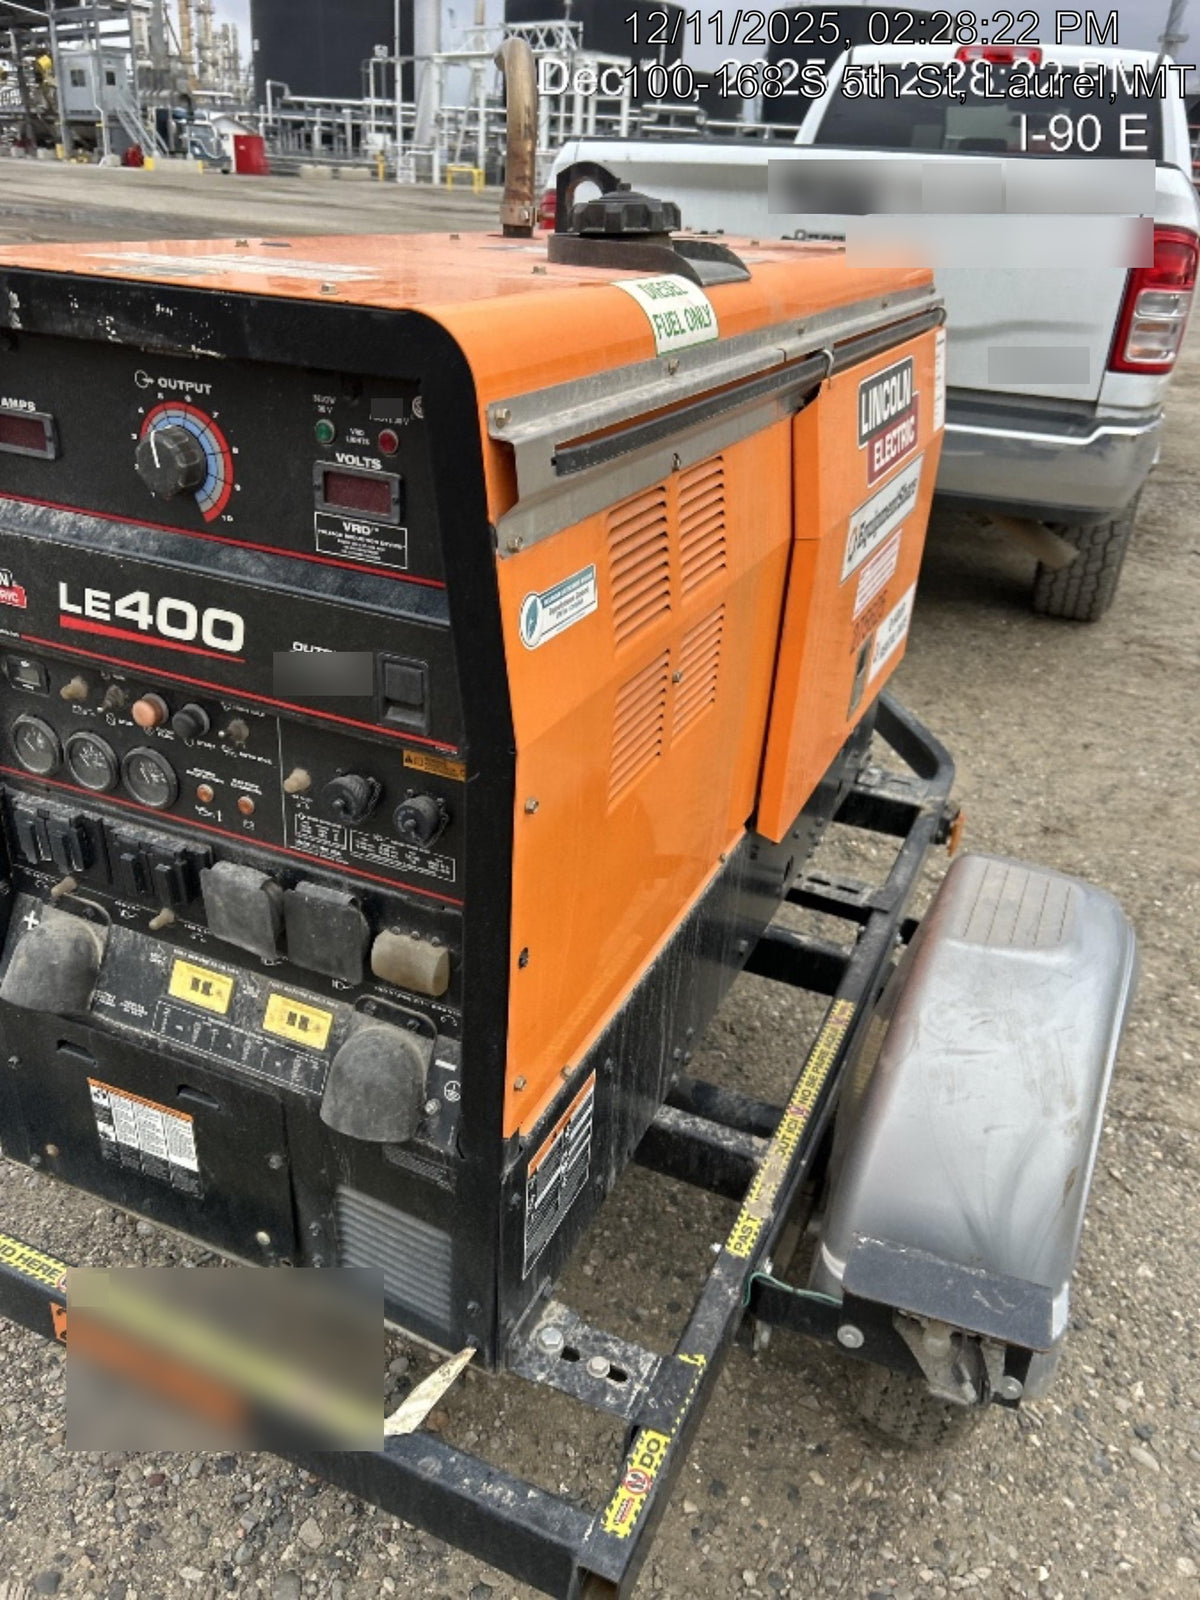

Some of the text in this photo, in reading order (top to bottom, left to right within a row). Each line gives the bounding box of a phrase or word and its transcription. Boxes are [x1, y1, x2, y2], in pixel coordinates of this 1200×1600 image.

[652, 304, 712, 339] FUEL ONLY
[157, 377, 212, 395] OUTPUT
[861, 366, 912, 436] LINCOLN
[873, 415, 915, 473] ELECTRIC
[335, 452, 383, 470] VOLTS
[58, 581, 245, 652] LE400
[16, 1252, 63, 1281] HERE
[640, 1438, 661, 1469] DO
